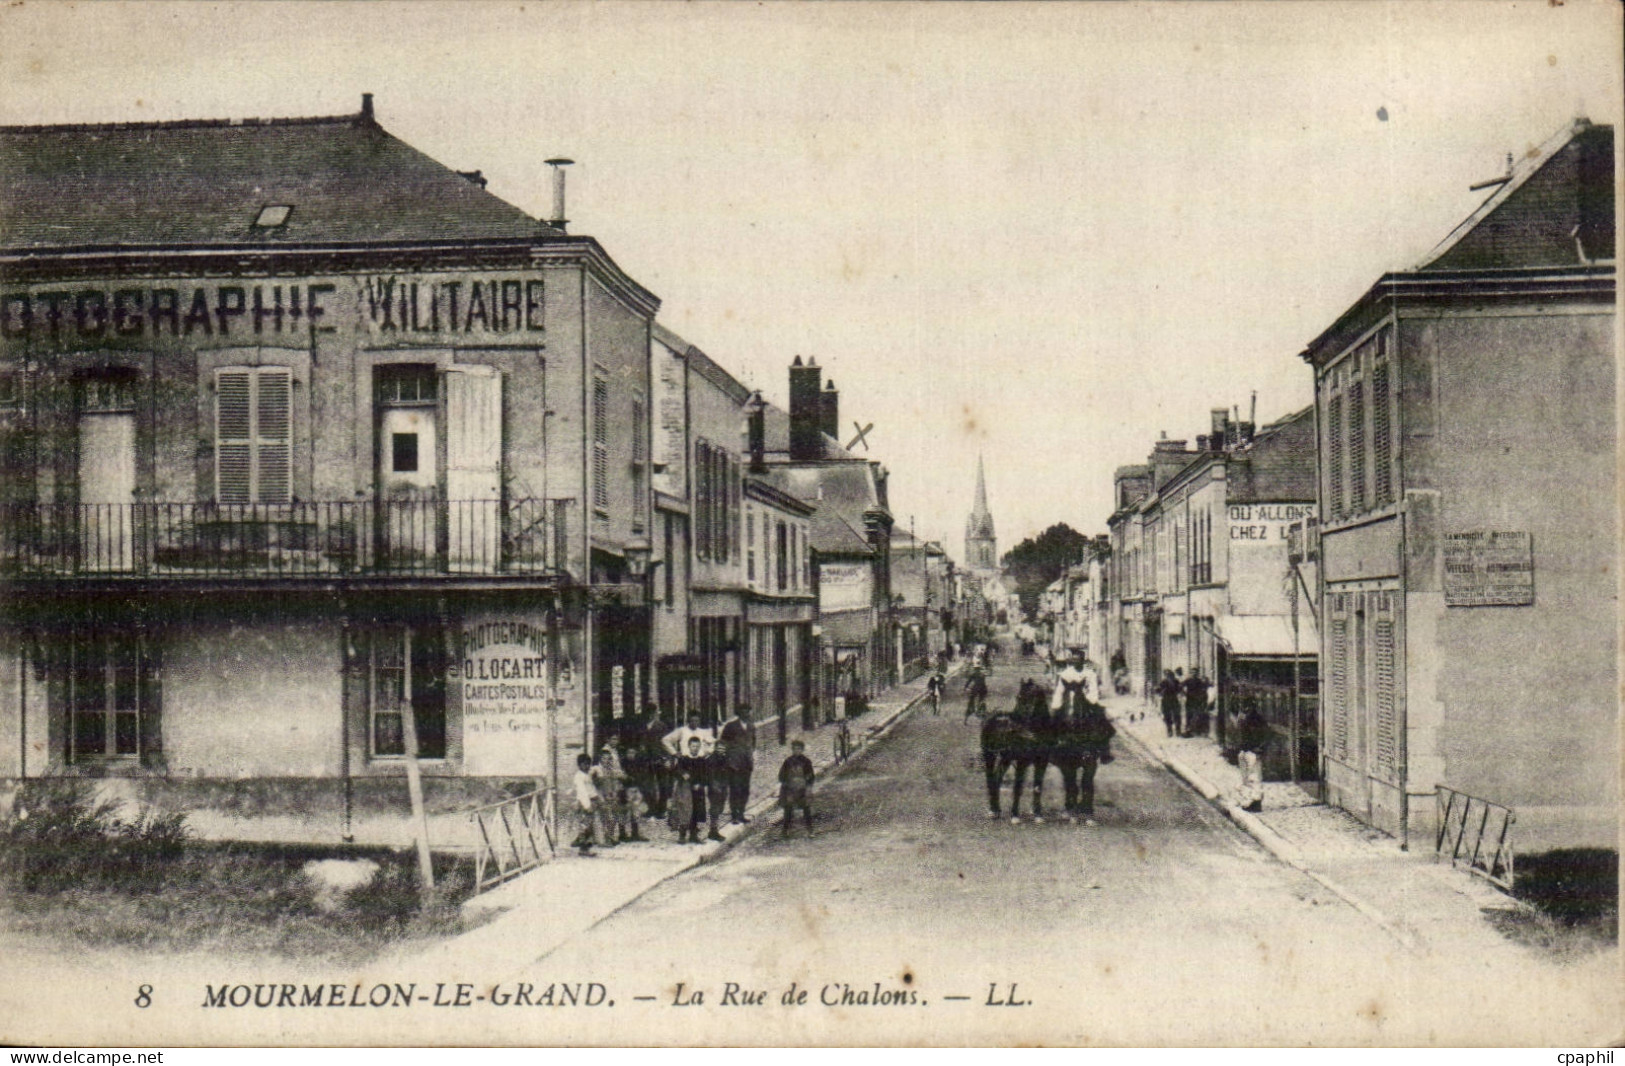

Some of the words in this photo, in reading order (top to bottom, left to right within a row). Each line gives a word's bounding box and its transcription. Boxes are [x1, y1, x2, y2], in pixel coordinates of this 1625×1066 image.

[1230, 525, 1268, 540] CHEZ
[463, 621, 547, 660] PHOTOGRAPHIE
[479, 658, 546, 680] LOCART
[465, 684, 499, 700] CARTES
[500, 684, 545, 700] POSTALES
